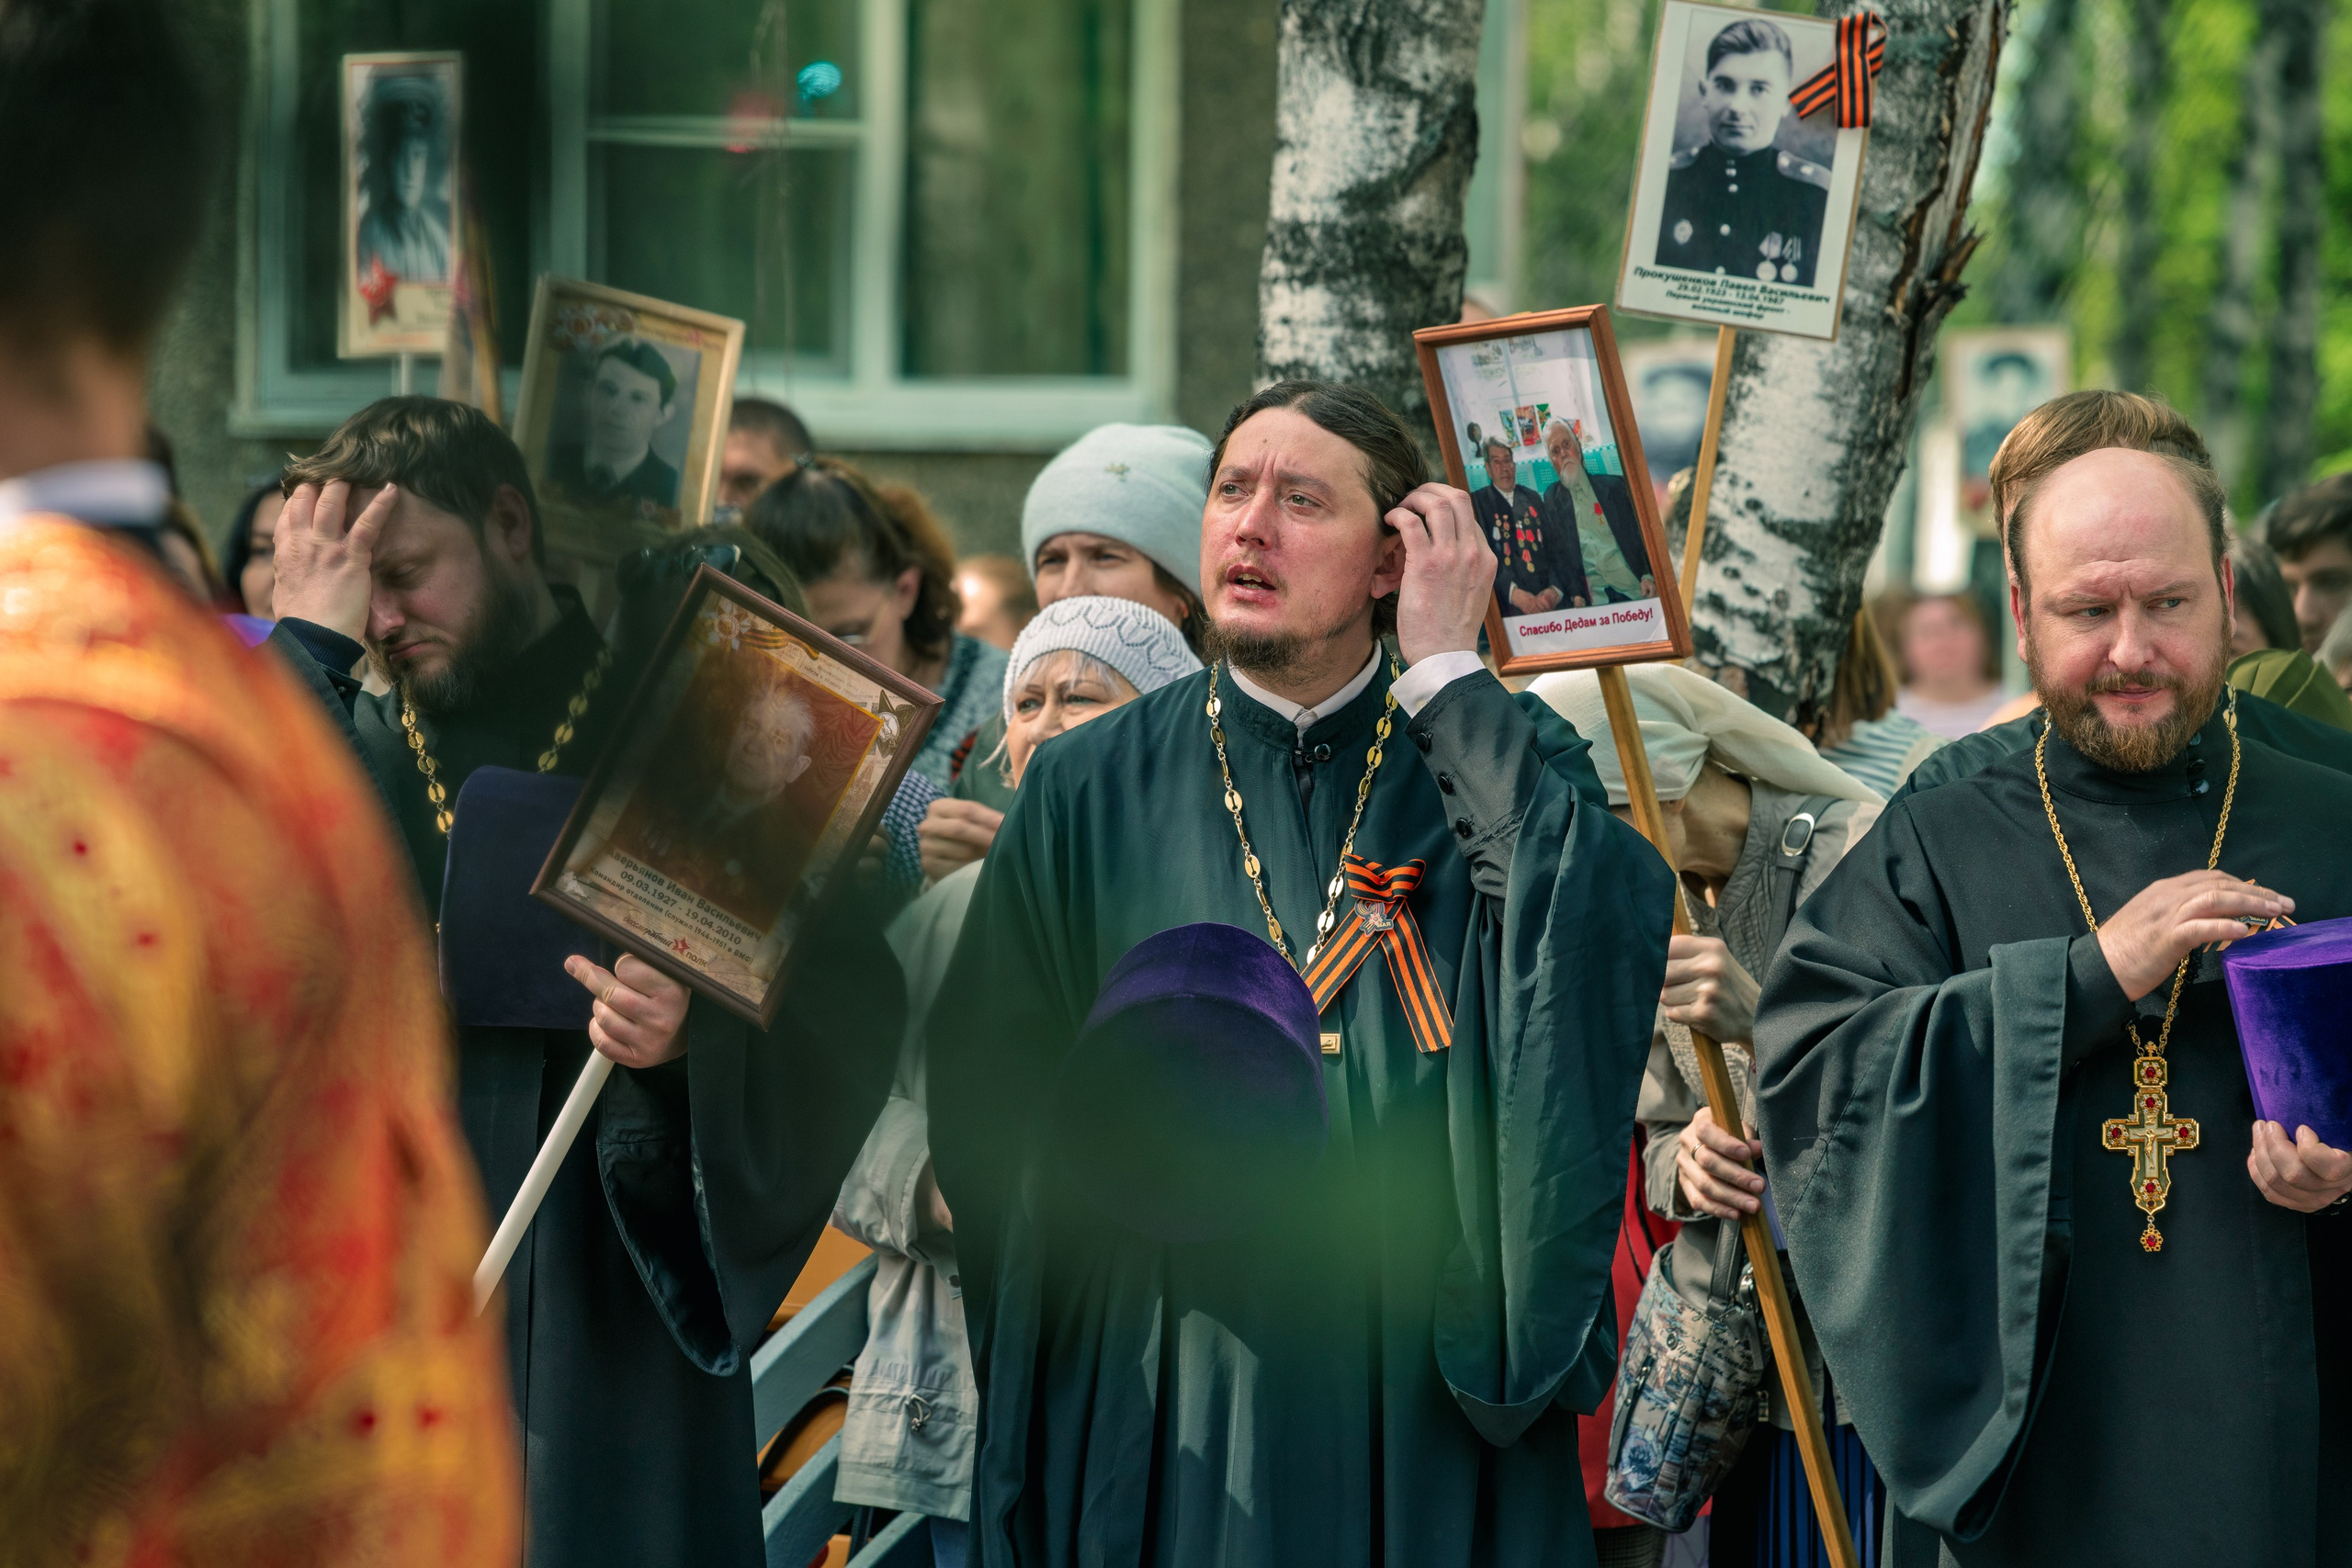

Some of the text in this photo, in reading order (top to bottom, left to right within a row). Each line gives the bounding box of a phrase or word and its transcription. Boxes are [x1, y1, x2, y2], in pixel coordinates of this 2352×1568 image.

[1720, 278, 1756, 292] Павел
[1759, 284, 1830, 304] Васильевич
[1520, 607, 1654, 637] Спасибо Дедам за Победу!
[589, 866, 625, 891] Командир
[626, 888, 663, 913] отделения
[664, 909, 693, 931] (служил
[694, 926, 727, 949] 1944-1951
[733, 949, 753, 965] ВМФ)
[607, 846, 762, 942] Аверьянов Иван Васильевич
[620, 871, 678, 908] 09.03.1927
[684, 908, 742, 945] 19.04.2010
